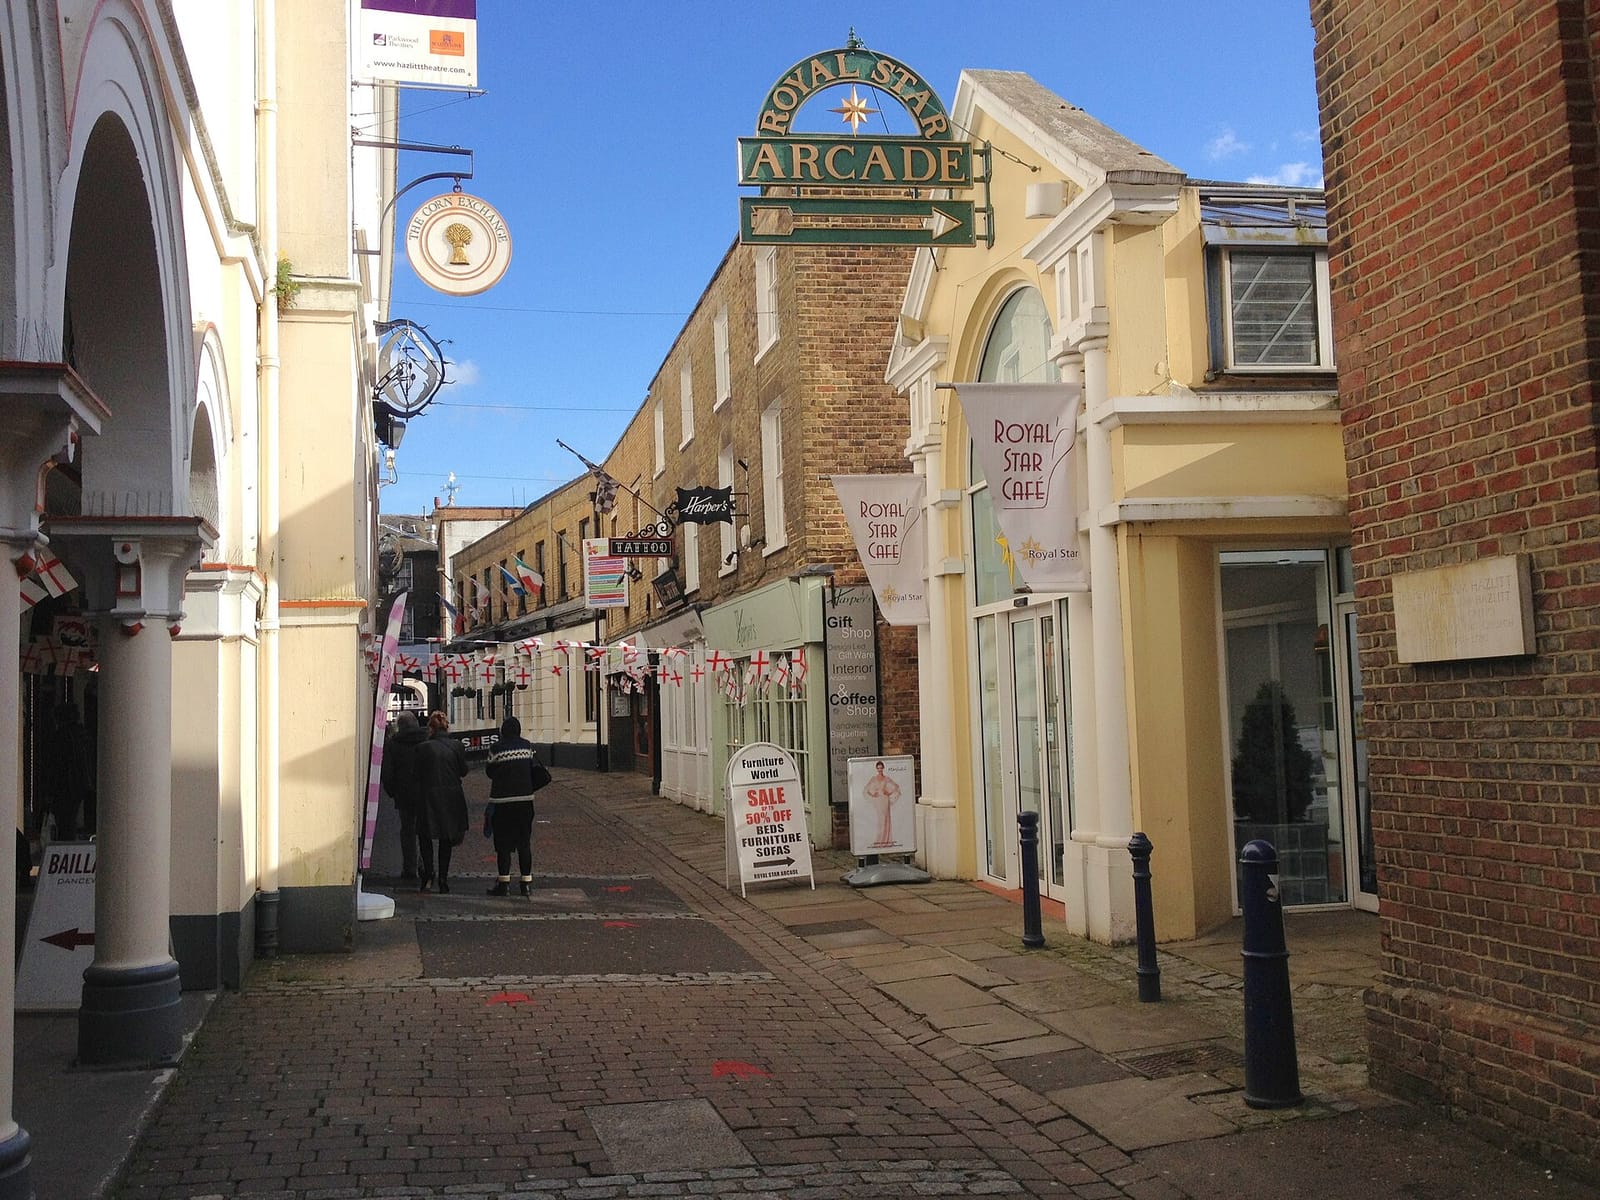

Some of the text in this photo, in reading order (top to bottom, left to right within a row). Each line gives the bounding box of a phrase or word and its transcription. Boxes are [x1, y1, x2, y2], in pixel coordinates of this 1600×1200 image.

[387, 34, 419, 44] Parkwood
[388, 40, 414, 49] Theatres
[373, 60, 466, 74] www.hazlitttheatre.com
[760, 53, 948, 140] ROYAL STAR
[747, 142, 966, 182] ARCADE
[408, 196, 508, 243] THE CORN EXCHANGE
[993, 419, 1054, 444] ROYAL
[1003, 447, 1043, 473] STAR
[1002, 476, 1045, 501] CAFÉ
[680, 495, 728, 516] Harper's
[860, 500, 905, 518] ROYAL
[868, 520, 898, 539] STAR
[615, 541, 668, 554] TATTOO
[868, 540, 899, 559] CAFÉ
[1028, 548, 1079, 561] Royal Star
[887, 593, 923, 602] Royal Star
[827, 616, 853, 628] Gift
[841, 627, 872, 640] Shop
[832, 663, 873, 674] Interior
[837, 683, 848, 698] &
[830, 692, 876, 706] Coffee
[846, 704, 876, 717] Shop
[831, 745, 870, 756] the best
[741, 757, 784, 769] Furniture
[750, 768, 779, 780] World
[747, 786, 786, 808] SALE
[745, 809, 792, 825] 50% OFF
[756, 823, 785, 835] BEDS
[741, 832, 802, 848] FURNITURE
[756, 844, 791, 858] SOFAS
[753, 872, 768, 880] ROYAL
[780, 869, 799, 877] ARCADE
